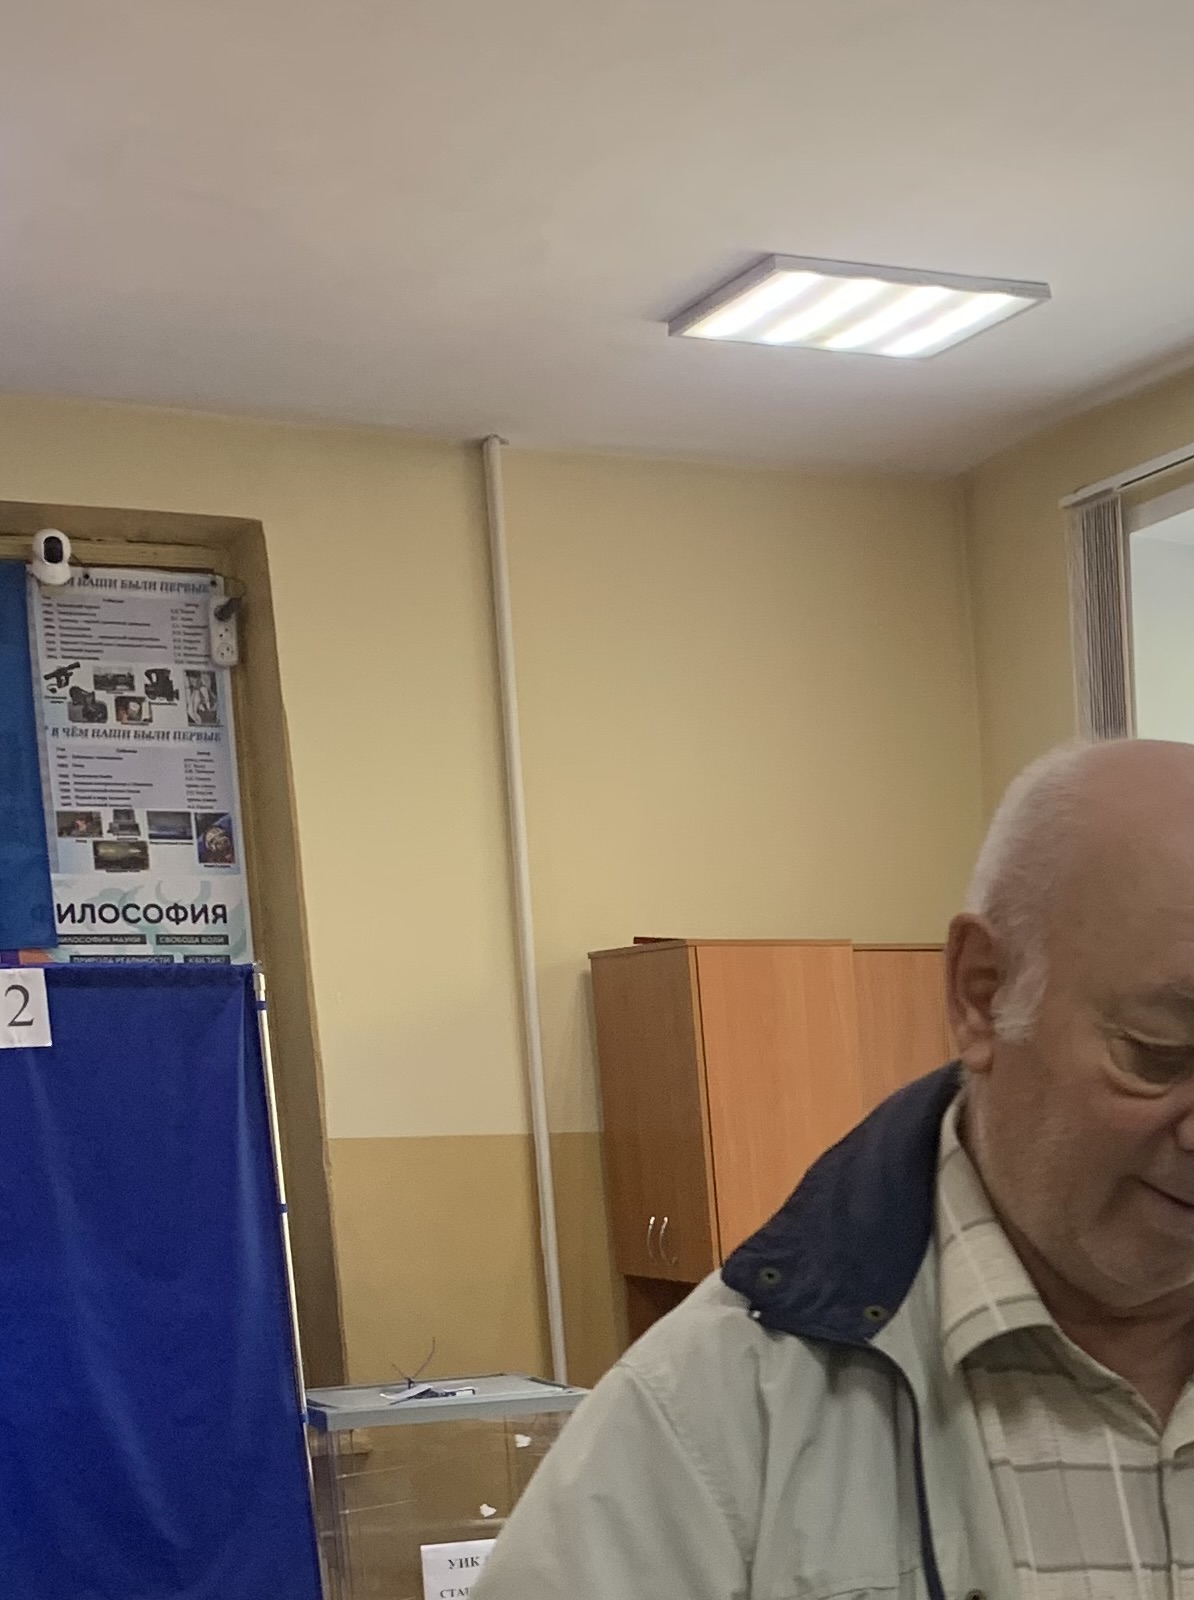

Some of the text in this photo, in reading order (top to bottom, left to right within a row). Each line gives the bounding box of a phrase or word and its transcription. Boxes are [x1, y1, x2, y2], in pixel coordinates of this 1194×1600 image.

[77, 576, 117, 589] НАШИ
[120, 579, 157, 592] БЫЛИ
[160, 580, 210, 594] ПЕРВЫЕ
[51, 727, 60, 738] В
[92, 728, 131, 740] НАШИ
[133, 729, 170, 741] БЫЛИ
[172, 730, 222, 743] ПЕРВЫЕ
[56, 903, 228, 925] ИЛОСОФИЯ
[159, 936, 200, 945] СВОБОДА
[4, 984, 35, 1027] 2
[447, 1556, 480, 1570] УИК
